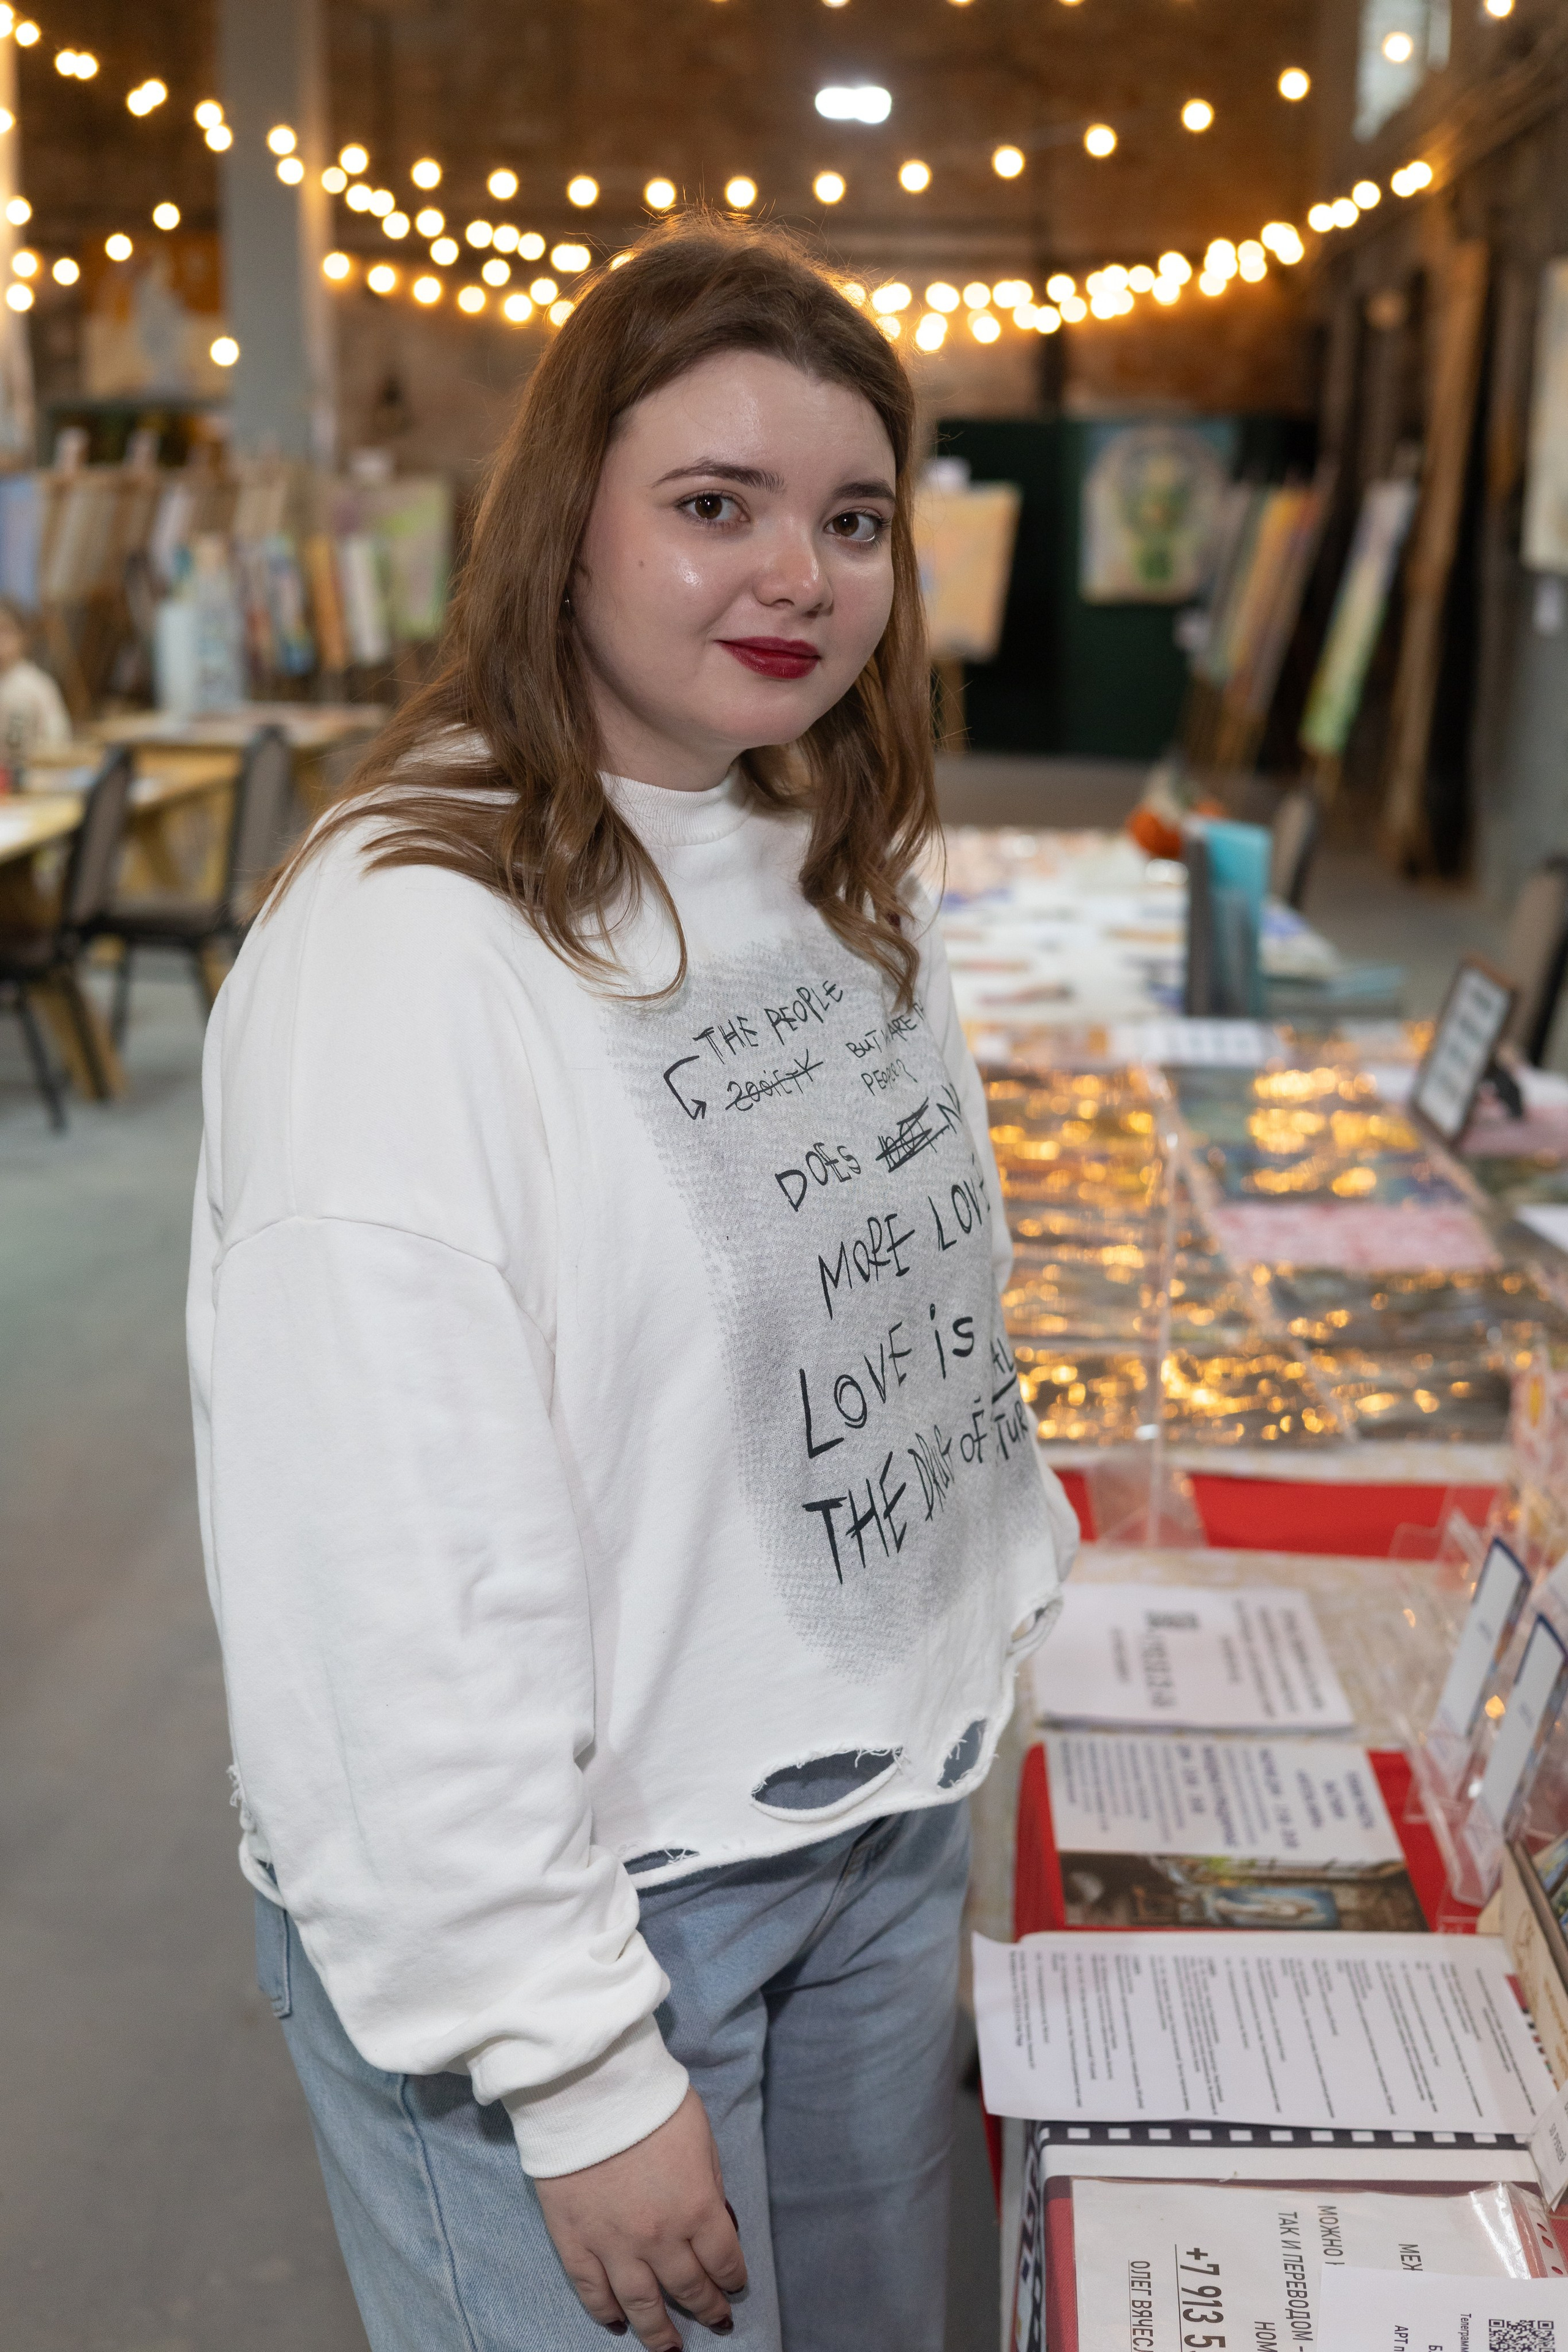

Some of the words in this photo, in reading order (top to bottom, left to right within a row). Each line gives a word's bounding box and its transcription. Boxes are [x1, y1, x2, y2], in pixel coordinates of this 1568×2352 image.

[693, 1016, 759, 1065] THE
[763, 980, 843, 1046] PEOPLE
[845, 1029, 882, 1058] BUT
[774, 1142, 861, 1213] DOES
[818, 1213, 915, 1321] MORE
[799, 1321, 912, 1459] LOVE
[802, 1451, 907, 1585] THE
[1278, 2212, 1300, 2236] ТАК
[1317, 2206, 1344, 2256] МОЖНО
[1180, 2247, 1220, 2276] +7
[1281, 2239, 1302, 2250] И
[1130, 2260, 1152, 2296] ОЛЕГ
[1283, 2253, 1314, 2341] ПЕРЕВОДОМ
[1181, 2285, 1224, 2324] 913
[1183, 2334, 1226, 2352] 5
[1394, 2324, 1409, 2345] АРТ
